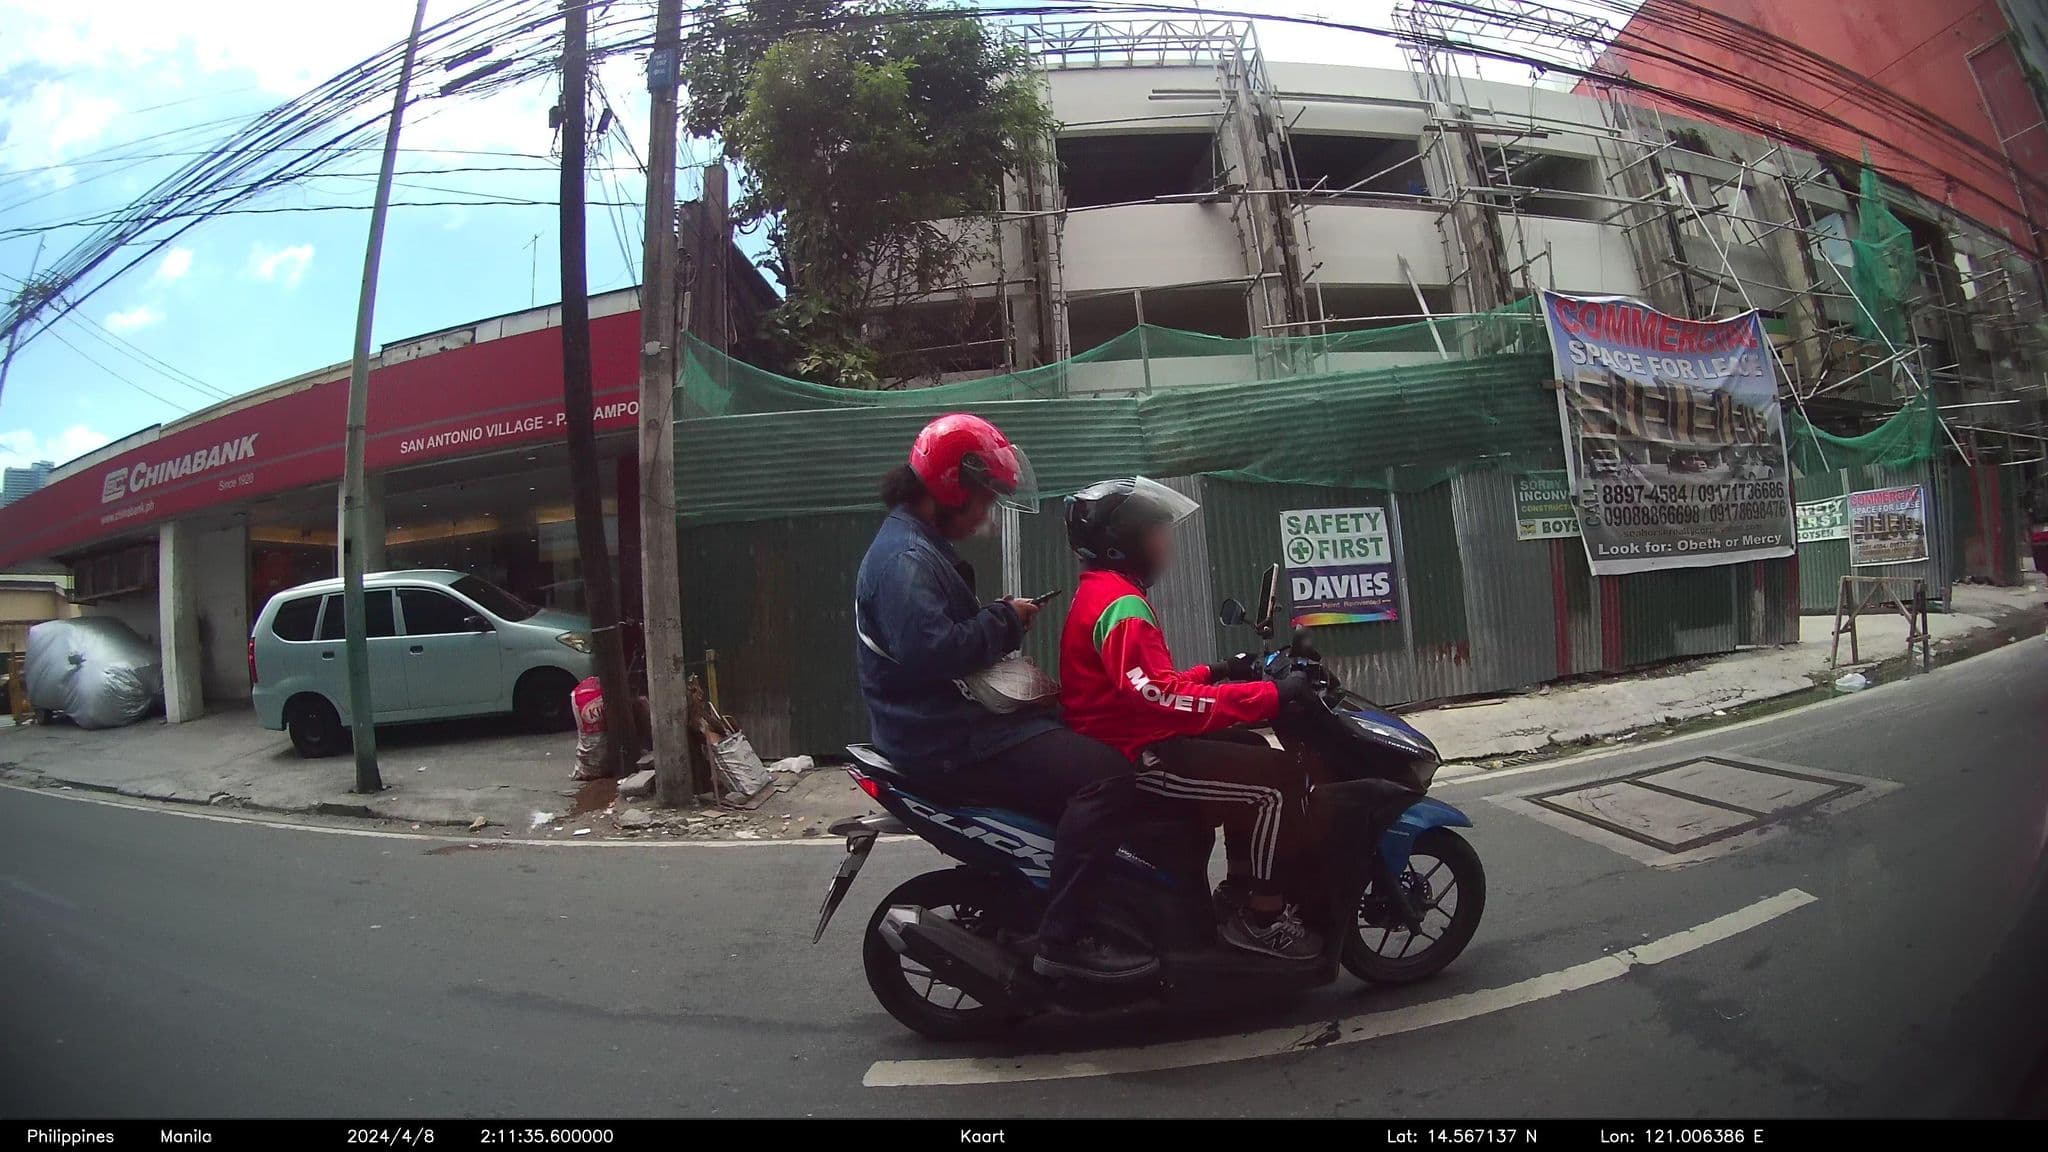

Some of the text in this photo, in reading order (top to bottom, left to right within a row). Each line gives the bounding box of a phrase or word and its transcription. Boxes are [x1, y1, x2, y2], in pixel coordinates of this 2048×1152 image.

[1567, 340, 1647, 376] SPACE
[1649, 356, 1698, 380] FOR
[400, 438, 424, 454] SAN
[427, 426, 483, 449] ANTONIO
[486, 416, 544, 438] VILLAGE
[593, 400, 640, 421] AMPO
[129, 433, 260, 493] CHINABANK
[1520, 490, 1570, 502] INCONV
[1603, 484, 1688, 505] 8897-4584
[1878, 504, 1895, 513] FOR
[1896, 501, 1921, 511] LEASE
[1286, 512, 1381, 535] SAFETY
[1542, 520, 1580, 534] BOYS
[1797, 513, 1843, 528] IRST
[1318, 537, 1383, 559] FIRST
[1598, 533, 1782, 556] Look for: Obeth or Mercy
[1291, 572, 1391, 601] DAVIES
[1126, 666, 1194, 712] MOVE
